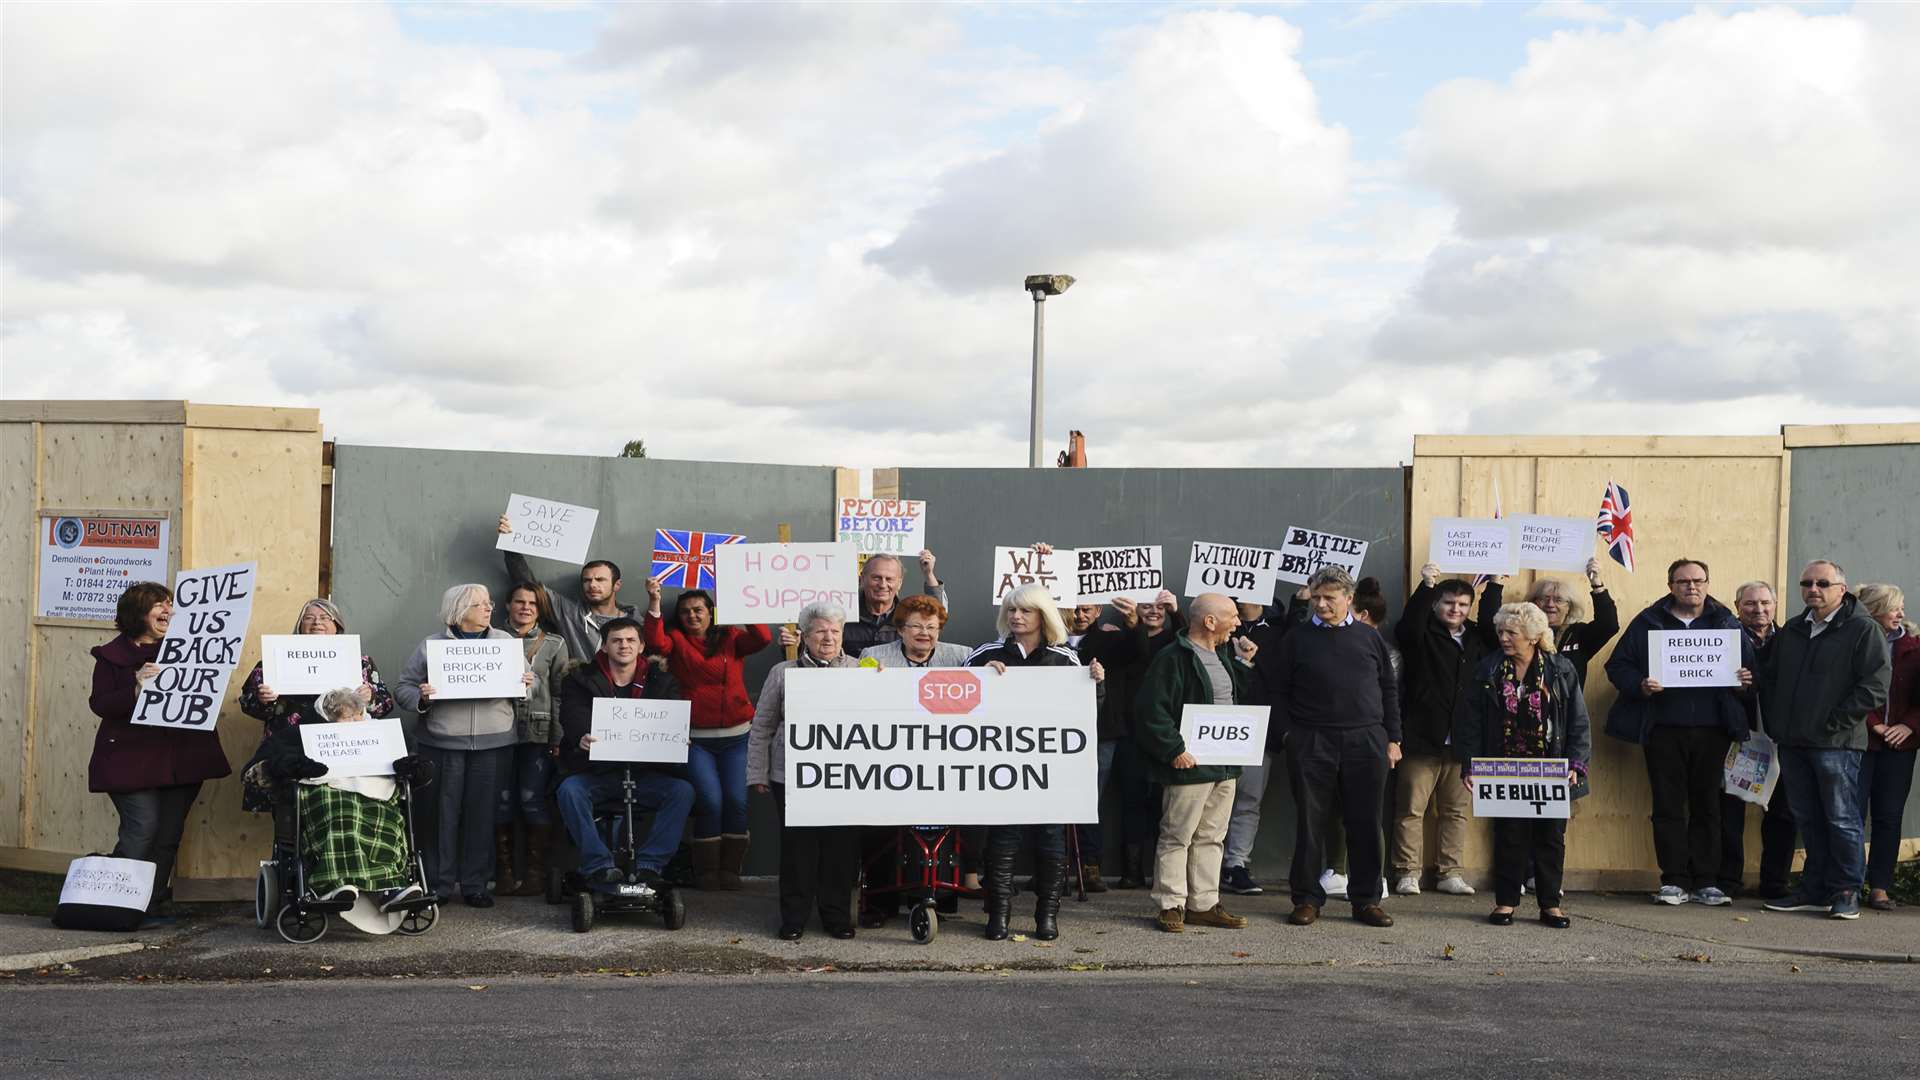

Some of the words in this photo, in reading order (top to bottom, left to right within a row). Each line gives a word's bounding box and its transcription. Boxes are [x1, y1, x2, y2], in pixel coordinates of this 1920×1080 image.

[520, 501, 576, 522] SAVE
[842, 497, 921, 517] PEOPLE
[87, 522, 157, 537] PUTNAM
[528, 521, 564, 536] OUR
[840, 517, 914, 532] BEFORE
[1523, 525, 1561, 536] PEOPLE
[839, 532, 909, 552] PROFIT
[1288, 529, 1363, 555] BATTLE
[1447, 531, 1472, 539] LAST
[1522, 535, 1561, 545] BEFORE
[1447, 540, 1488, 549] ORDERS
[1490, 541, 1503, 549] AT
[1521, 544, 1557, 553] PROFIT
[52, 555, 93, 564] Demolition
[100, 556, 152, 566] Groundworks
[745, 551, 836, 572] HOOT
[1077, 548, 1152, 571] BROKEN
[1193, 544, 1275, 570] WITHOUT
[1308, 549, 1327, 561] OF
[1447, 550, 1466, 558] THE
[1468, 550, 1489, 558] BAR
[1008, 551, 1054, 575] WE
[84, 567, 104, 576] Plant
[106, 568, 122, 576] Hire
[1201, 567, 1256, 590] OUR
[65, 577, 73, 588] T:
[76, 579, 105, 588] 01844
[176, 568, 249, 608] GIVE
[1077, 569, 1163, 595] HEARTED
[62, 591, 74, 601] M:
[76, 592, 105, 602] 07872
[742, 585, 857, 609] SUPPORT
[189, 610, 231, 635] US
[1668, 637, 1723, 647] REBUILD
[159, 637, 242, 665] BACK
[287, 650, 337, 659] REBUILD
[446, 646, 501, 655] REBUILD
[1670, 654, 1704, 663] BRICK
[1707, 654, 1722, 663] BY
[308, 665, 319, 674] IT
[443, 662, 503, 672] BRICK-BY
[1679, 669, 1713, 678] BRICK
[154, 666, 220, 693] OUR
[448, 674, 487, 683] BRICK
[923, 683, 977, 700] STOP
[137, 689, 213, 725] PUB
[316, 733, 338, 741] TIME
[789, 723, 1087, 754] UNAUTHORISED
[1198, 725, 1250, 740] PUBS
[318, 739, 379, 749] GENTLEMEN
[319, 748, 361, 757] PLEASE
[796, 762, 1049, 791] DEMOLITION
